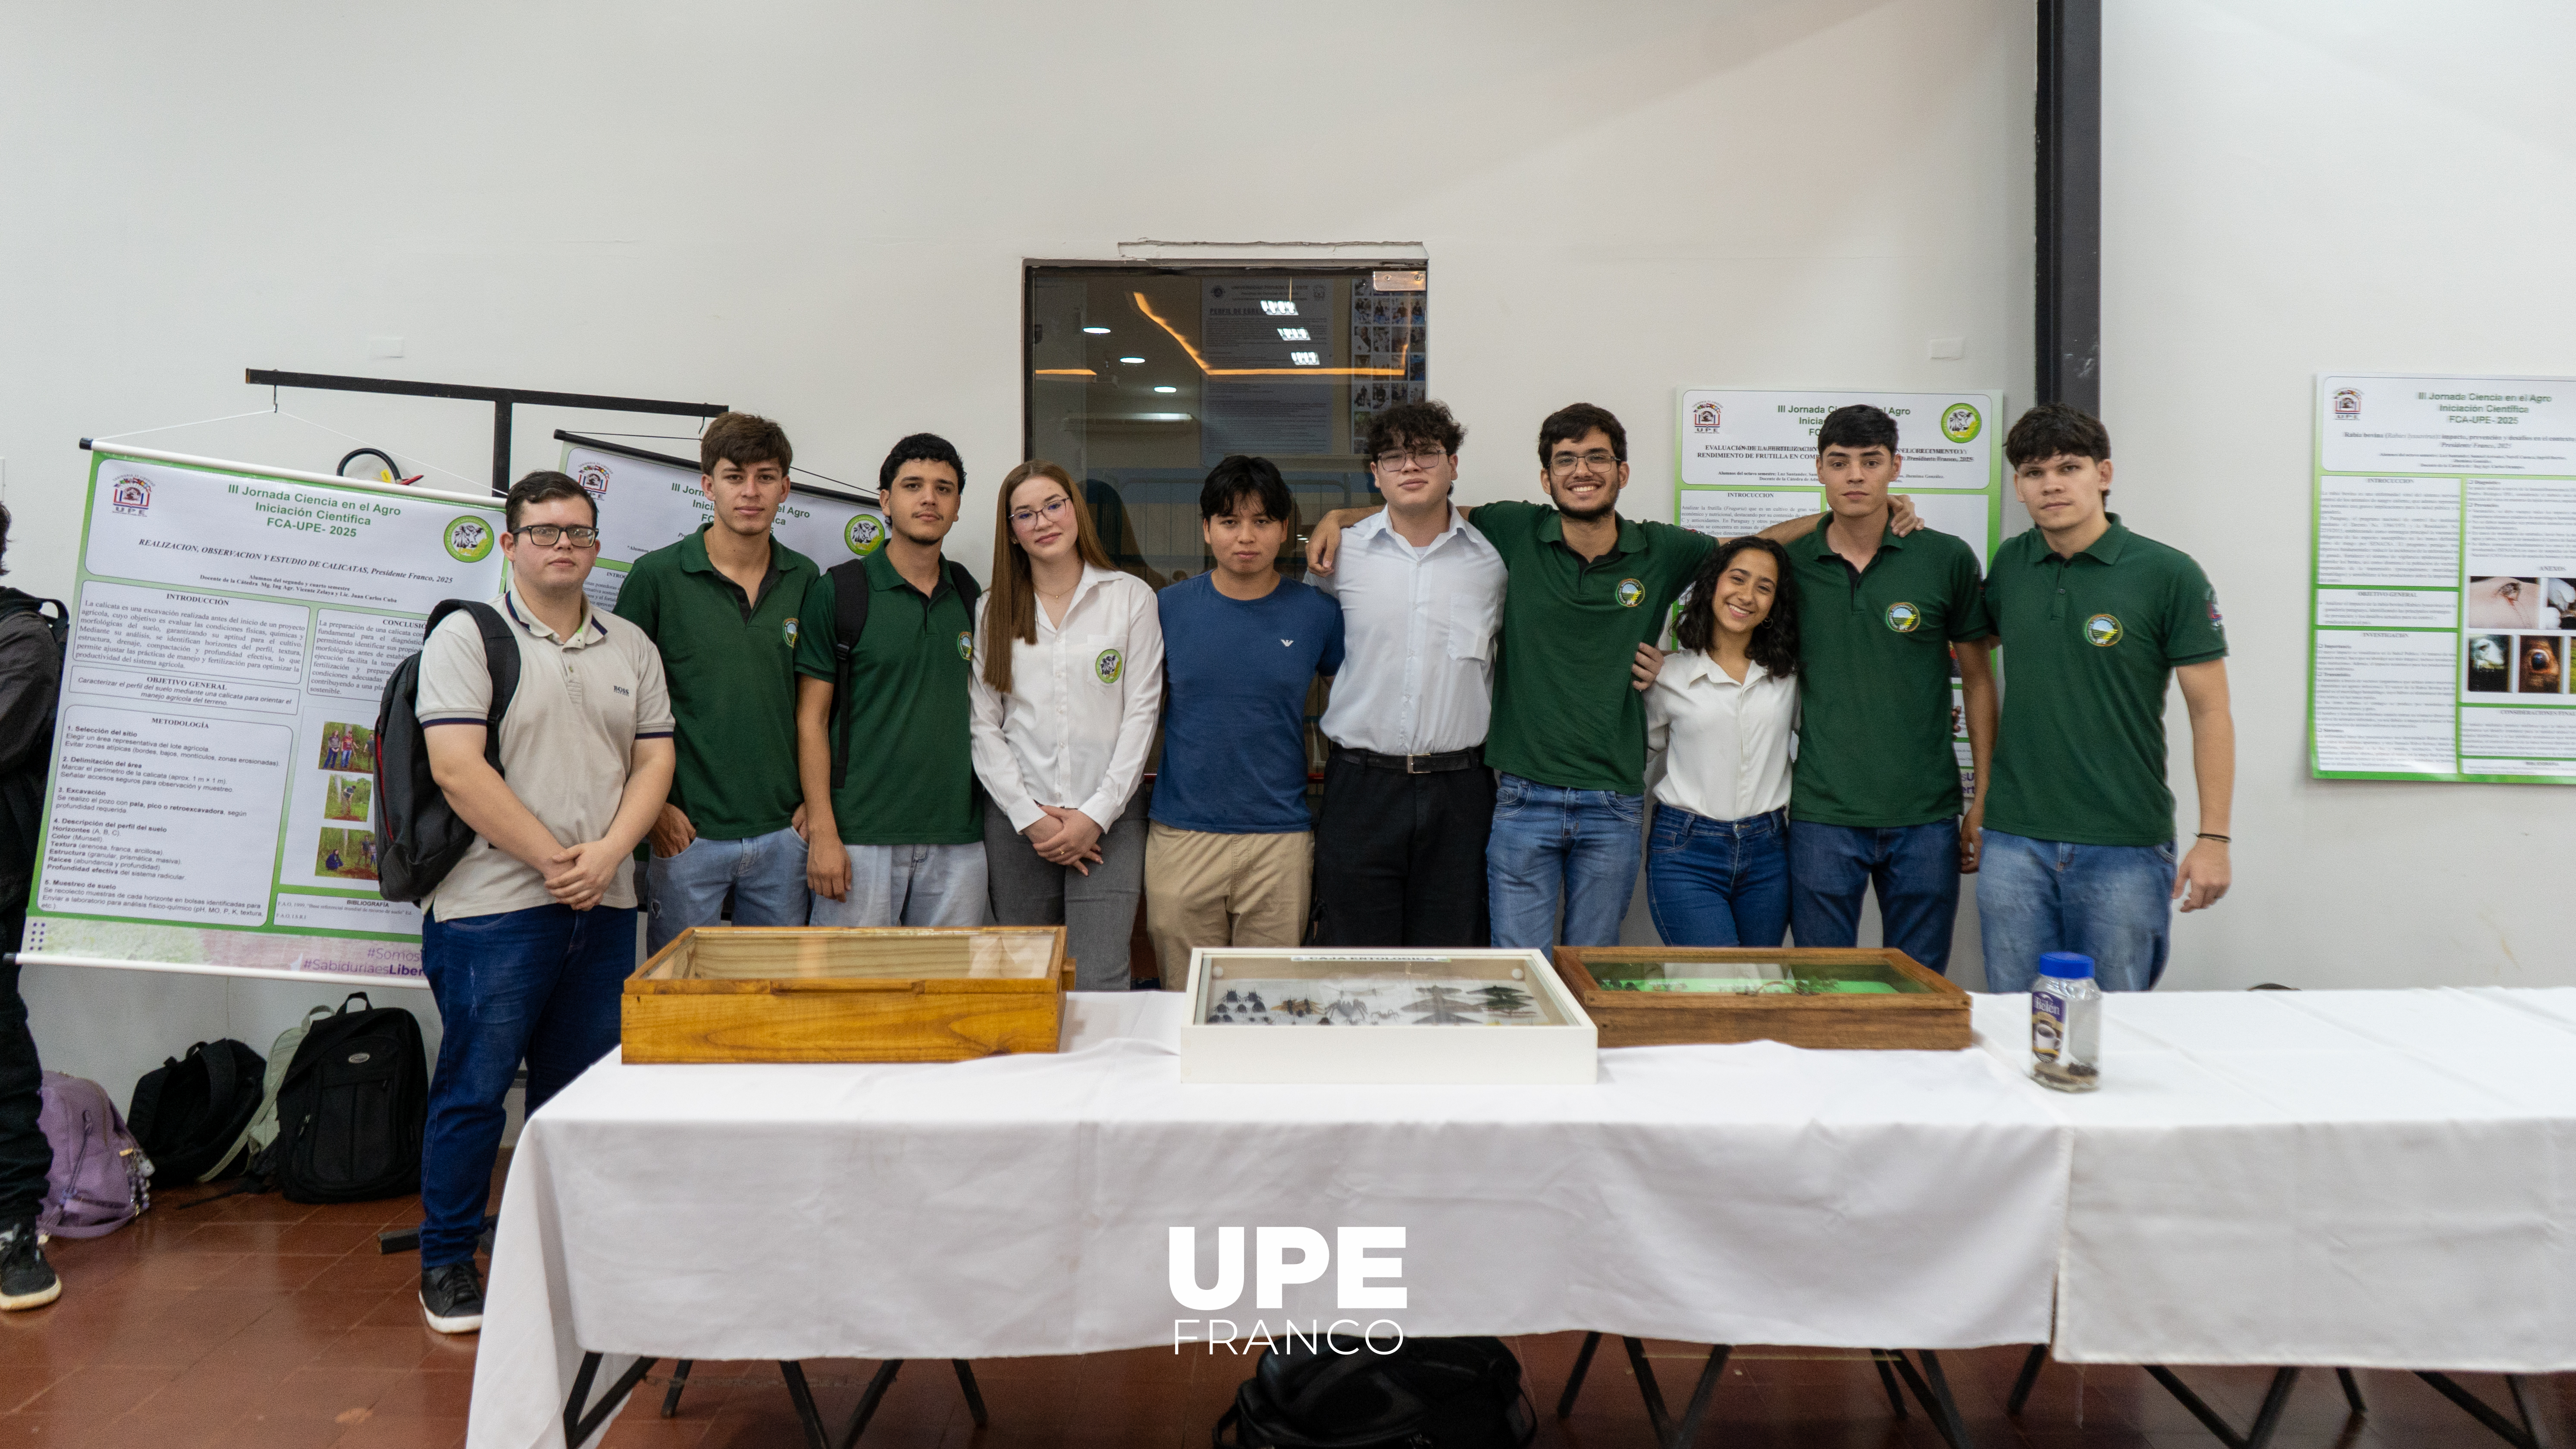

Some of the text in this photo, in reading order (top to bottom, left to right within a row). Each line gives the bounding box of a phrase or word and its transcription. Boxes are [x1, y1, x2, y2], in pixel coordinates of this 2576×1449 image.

[2429, 392, 2466, 401] Jornada
[2469, 393, 2502, 401] Ciencia
[2529, 394, 2552, 404] Agro
[1788, 405, 1825, 414] Jornada
[1889, 407, 1911, 416] Agro
[2439, 404, 2529, 413] Iniciación Científica
[682, 486, 706, 497] Jorn
[228, 484, 401, 516] III Jornada Ciencia en el Agro
[116, 507, 146, 515] UPE
[255, 502, 371, 526] Iniciación Científica
[787, 507, 810, 518] Agro
[267, 517, 357, 537] FCA-UPE- 2025
[138, 539, 199, 553] REALIZACION,
[201, 547, 262, 559] OBSERVACION
[270, 555, 307, 566] ESTUDIO
[322, 562, 369, 574] CALICATAS,
[371, 568, 407, 578] Presidente
[408, 572, 434, 582] Franco,
[166, 593, 229, 605] INTRODUCCIÓN
[95, 602, 120, 610] calicata
[143, 608, 179, 617] excavación
[181, 612, 210, 620] realizada
[329, 622, 364, 630] preparación
[382, 619, 427, 630] CONCLUSIÓ
[78, 677, 118, 686] Caracterizar
[173, 688, 204, 696] mediante
[147, 677, 227, 690] OBJETIVO GENERAL
[614, 685, 629, 695] BOSS
[152, 718, 209, 729] METODOLOGÍA
[75, 726, 109, 734] Selección
